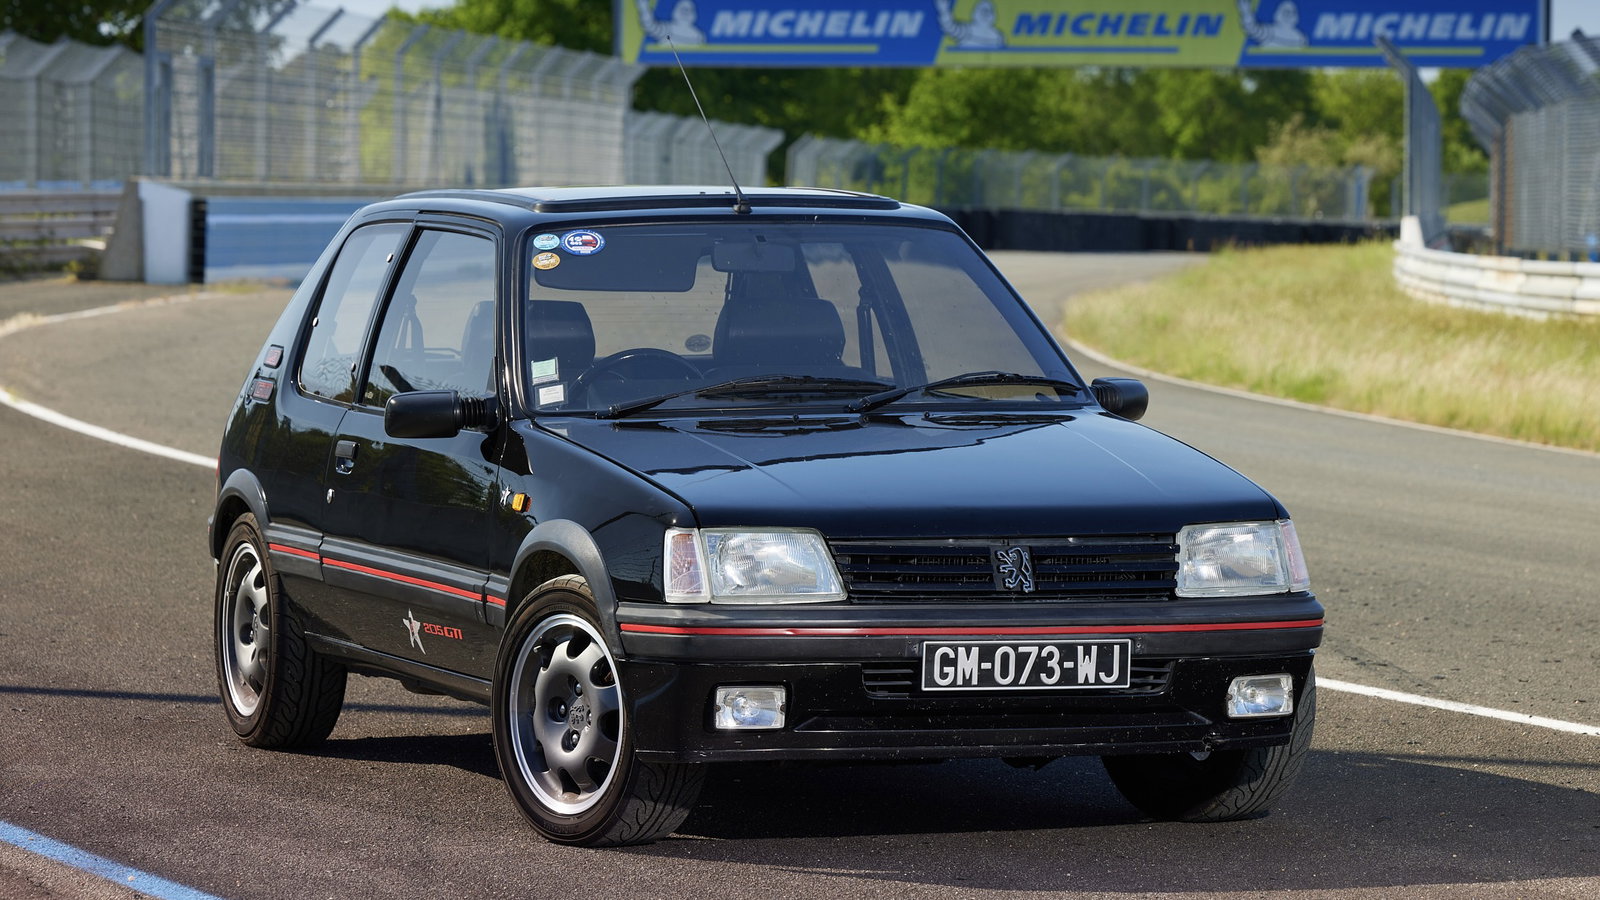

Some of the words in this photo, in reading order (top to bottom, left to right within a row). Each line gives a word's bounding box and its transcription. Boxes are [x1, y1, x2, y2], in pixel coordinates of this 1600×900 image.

[710, 10, 924, 37] MICHELIN
[1012, 13, 1224, 37] MICHELIN
[1313, 13, 1531, 40] MICHELIN
[933, 645, 1121, 686] GM-073-WJ
